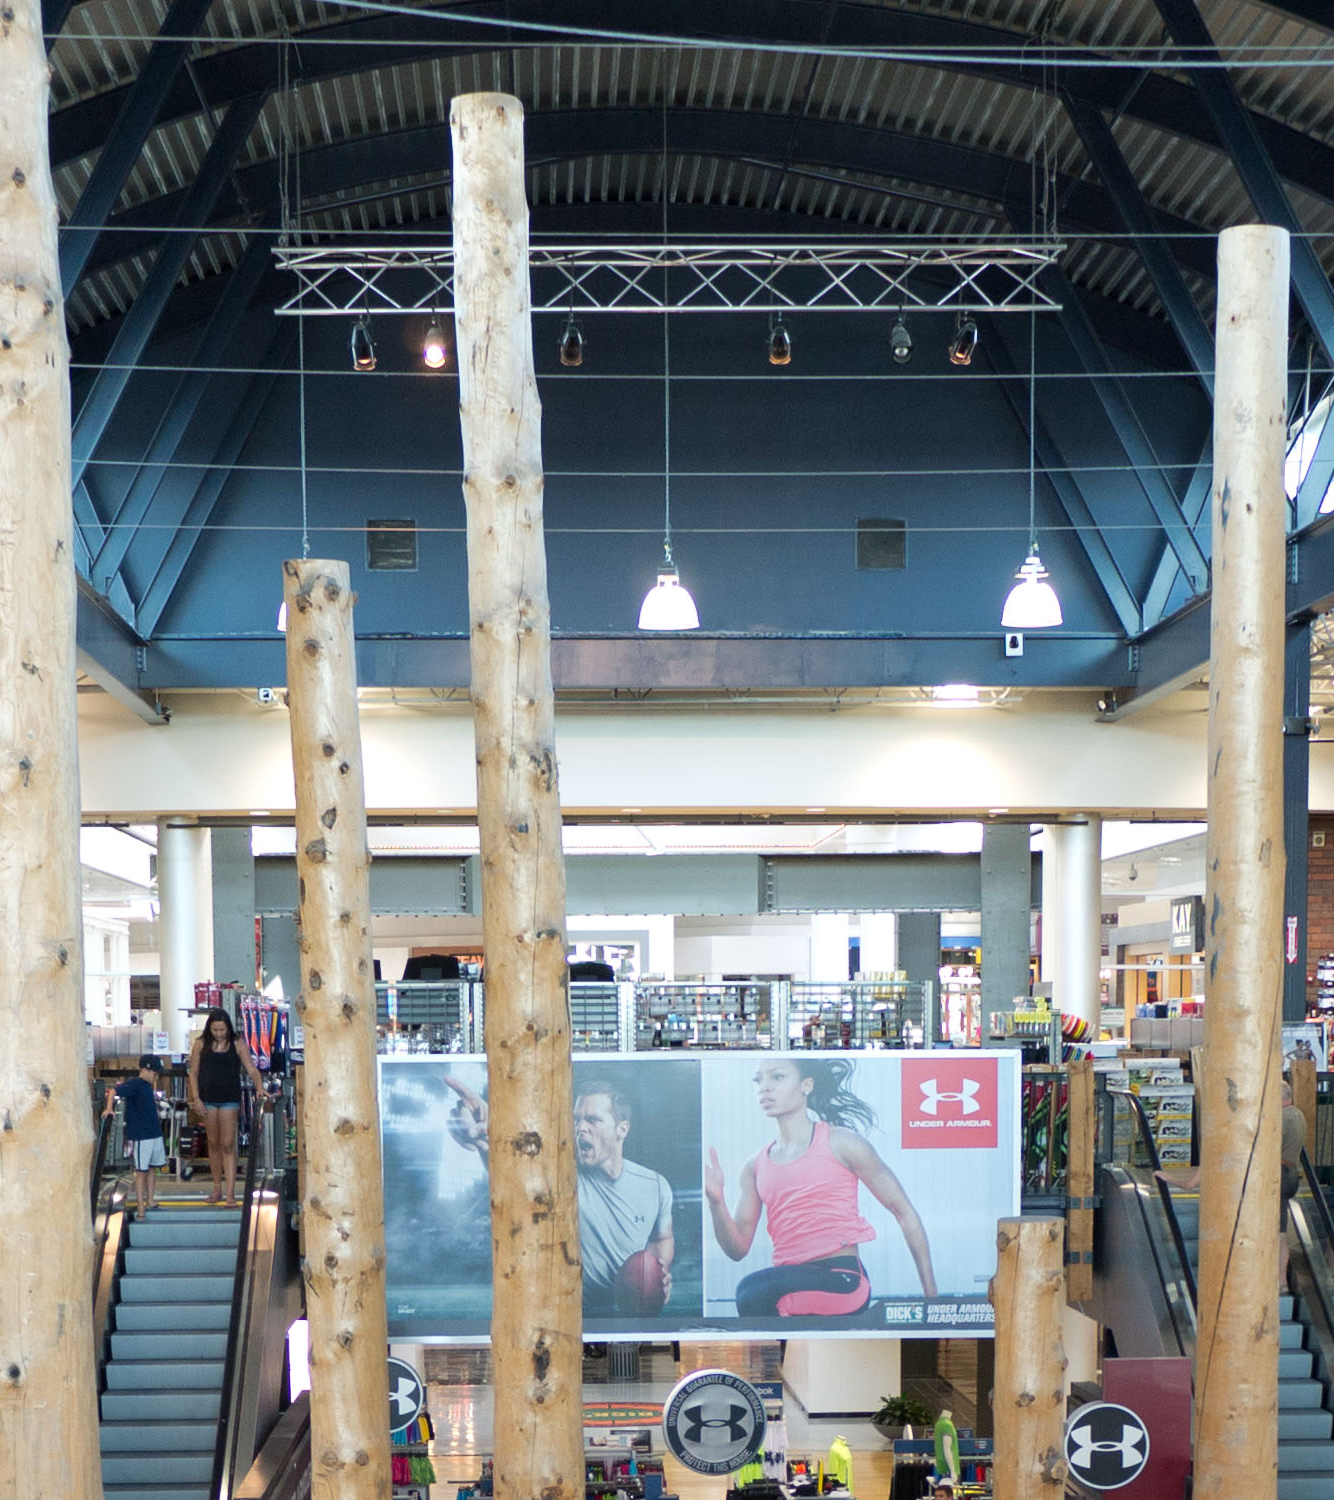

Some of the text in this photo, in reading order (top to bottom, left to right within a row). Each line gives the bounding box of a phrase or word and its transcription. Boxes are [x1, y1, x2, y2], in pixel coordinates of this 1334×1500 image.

[1172, 903, 1192, 934] KAY
[909, 1120, 991, 1128] UNDER ARMOUR
[886, 1305, 923, 1320] DICK'S
[927, 1304, 995, 1313] UNDER ARMOU
[679, 1449, 753, 1472] PROTECT THIS HOUSE
